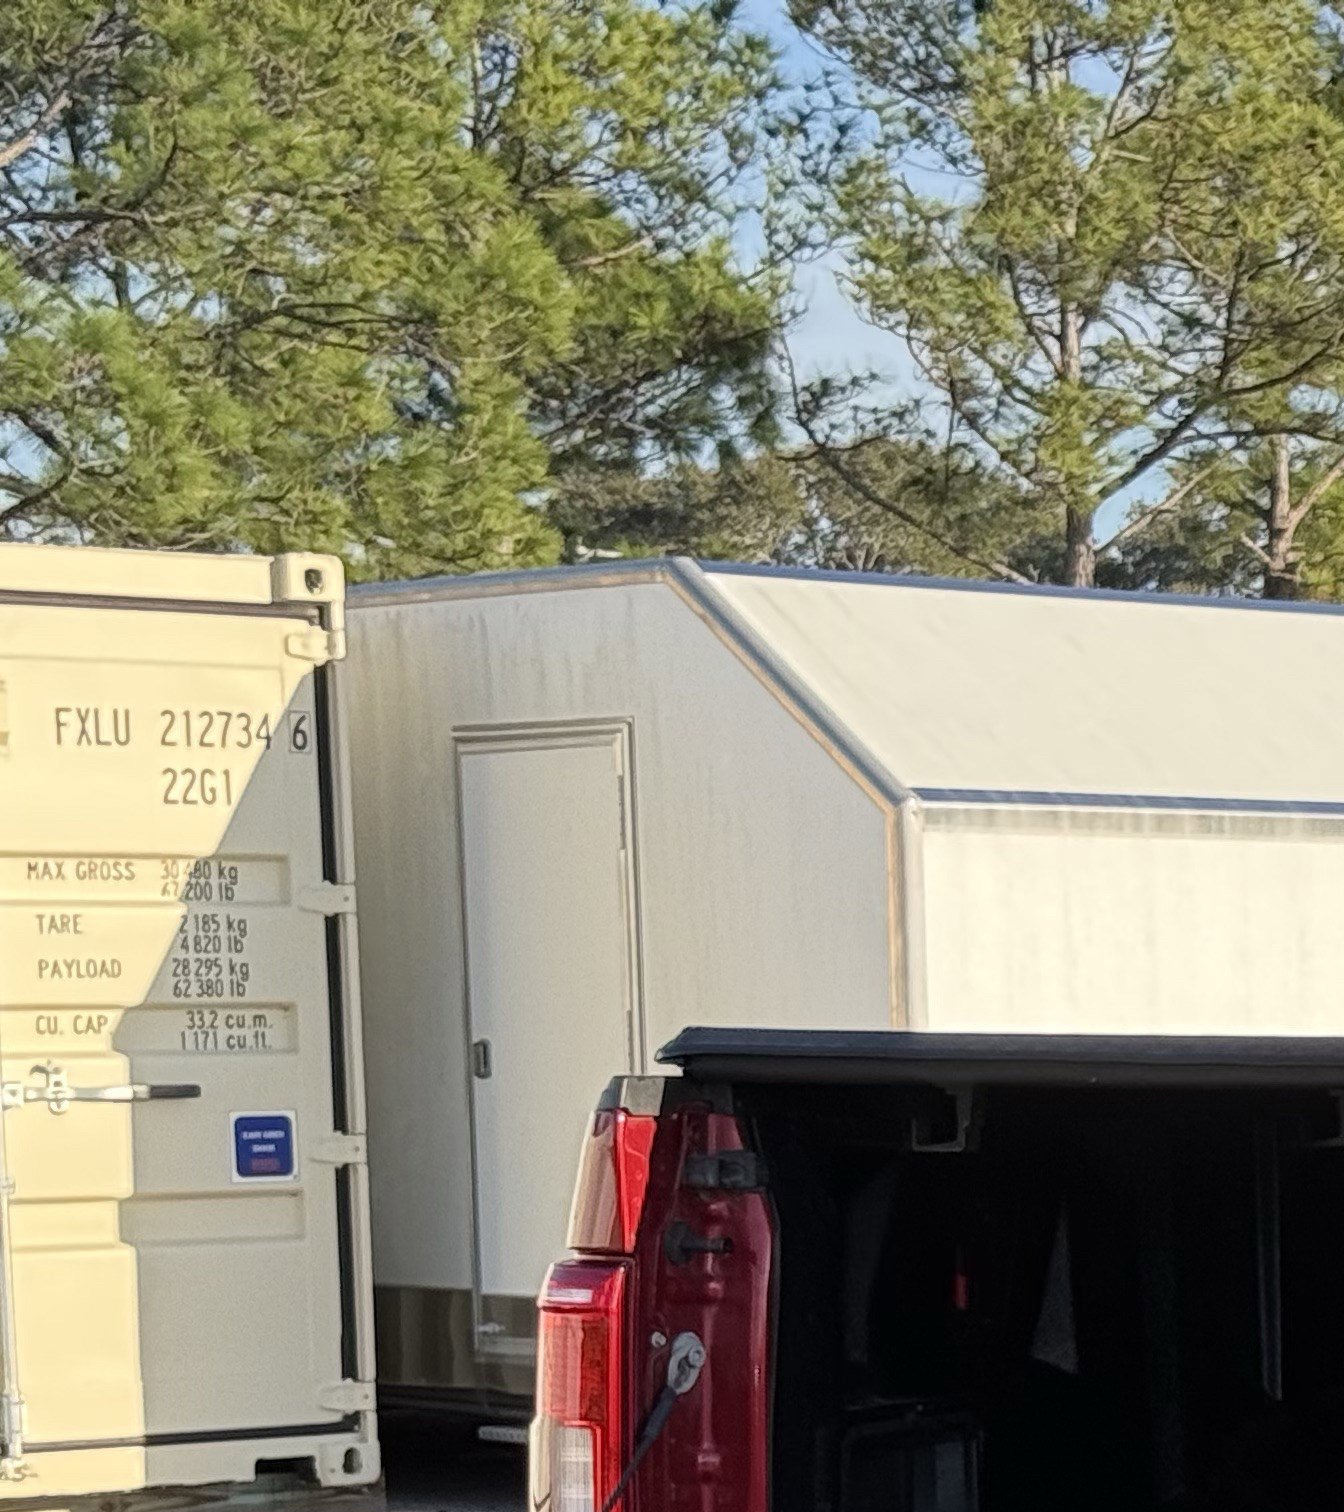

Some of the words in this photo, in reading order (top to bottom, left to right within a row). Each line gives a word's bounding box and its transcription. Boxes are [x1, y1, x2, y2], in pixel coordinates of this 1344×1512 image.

[54, 706, 131, 746] FXLU
[160, 709, 273, 751] 212734
[292, 713, 309, 751] 6
[162, 767, 233, 806] 22G1
[27, 861, 66, 881] MAX
[75, 861, 136, 881] GROSS
[218, 860, 239, 886] kg
[218, 881, 236, 902] lb
[35, 913, 84, 935] TARE
[226, 913, 248, 939] kg
[227, 934, 245, 954] lb
[37, 958, 123, 979] PAYLOAD
[228, 957, 250, 983] kg
[229, 978, 247, 998] lb
